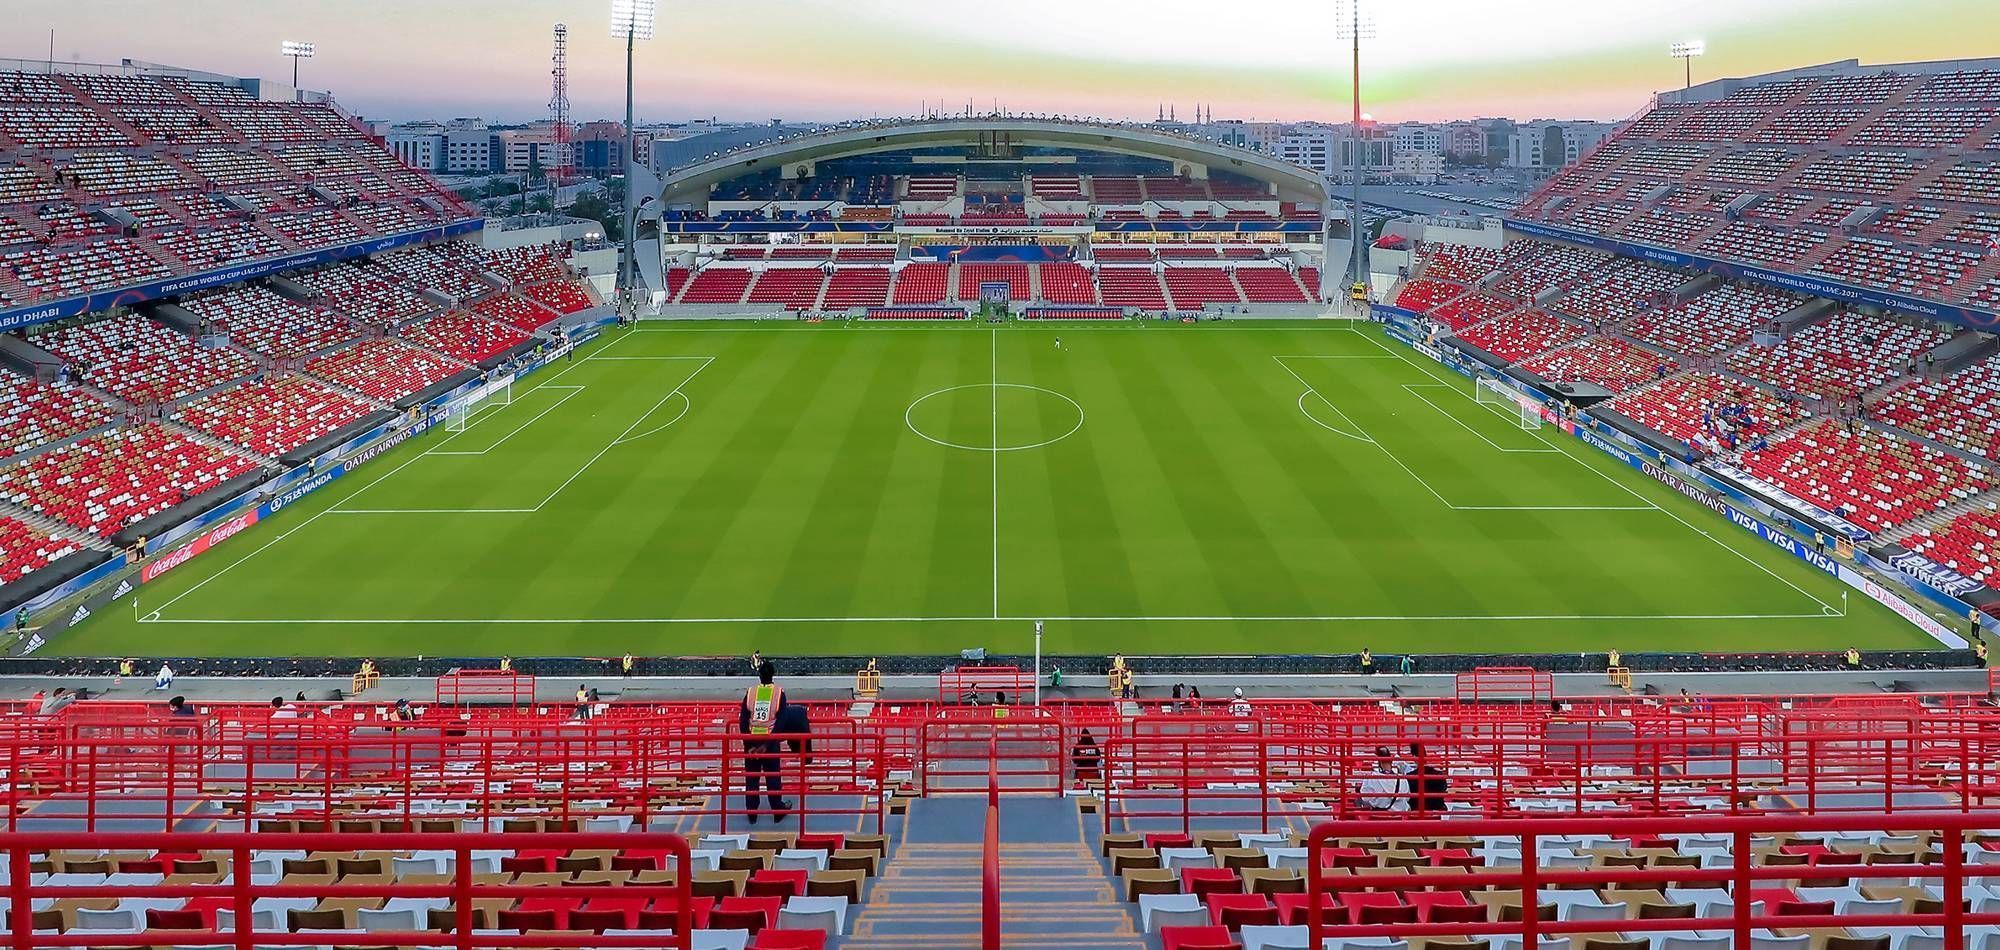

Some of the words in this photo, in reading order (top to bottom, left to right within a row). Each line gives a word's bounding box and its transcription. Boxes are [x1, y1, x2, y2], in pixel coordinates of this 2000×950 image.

[1645, 251, 1657, 259] ABU
[1658, 253, 1677, 263] DHABI
[161, 283, 178, 293] FIFA
[179, 279, 199, 289] CLUB
[200, 275, 226, 286] WORLD
[227, 272, 241, 280] CUP
[1743, 270, 1758, 279] FIFA
[1758, 272, 1776, 283] CLUB
[1777, 276, 1804, 288] WORLD
[1806, 281, 1821, 291] CUP
[23, 307, 60, 323] DHABI
[1896, 301, 1919, 313] Alibaba
[1919, 305, 1937, 315] Cloud
[344, 448, 375, 472] QATAR
[376, 427, 413, 455] AIRWAYS
[1641, 462, 1677, 489] QATAR
[1678, 481, 1727, 515] AIRWAYS
[1729, 508, 1759, 534] VISA
[1764, 525, 1796, 553] VISA
[1801, 545, 1837, 576] VISA
[1905, 554, 1980, 588] BLUE
[112, 585, 133, 601] adidas
[1882, 592, 1914, 620] Alibaba
[1914, 612, 1940, 636] Cloud
[756, 711, 767, 720] 19
